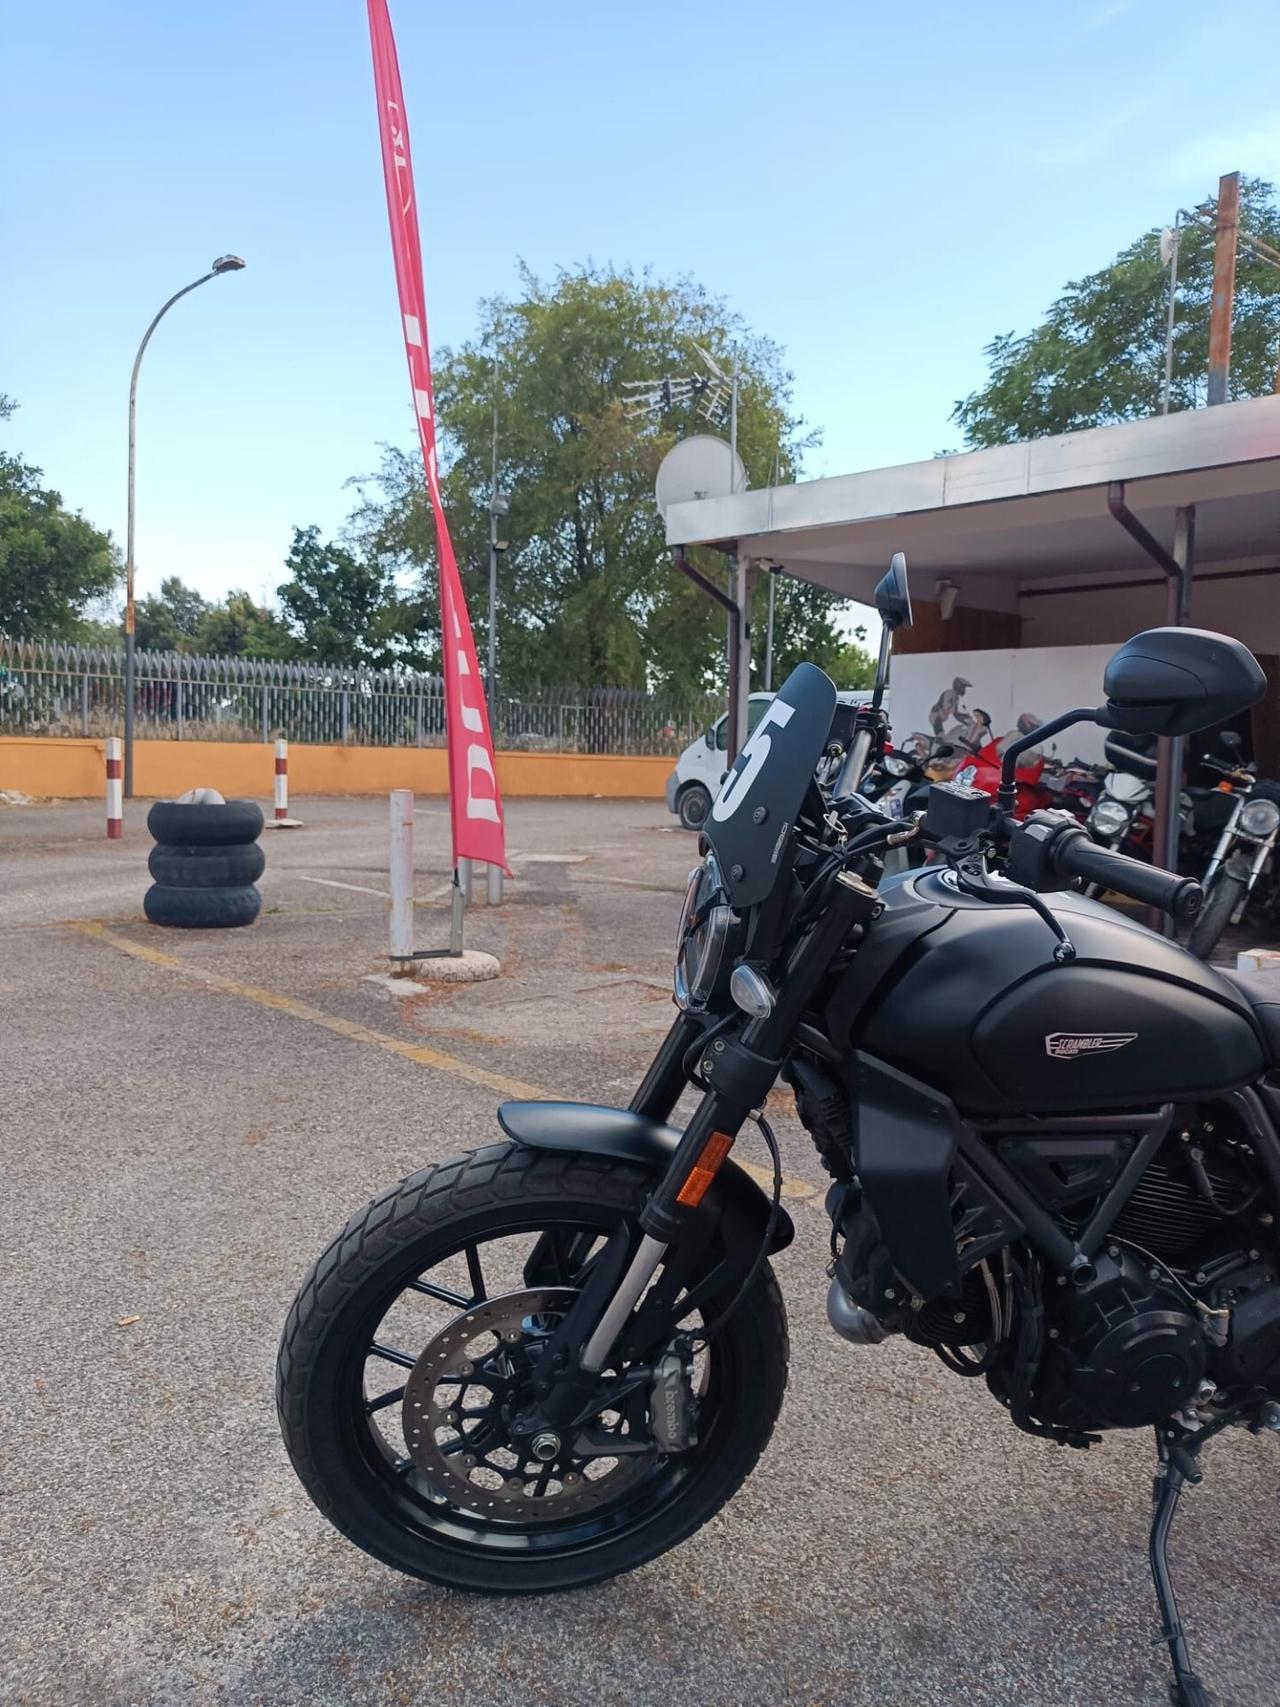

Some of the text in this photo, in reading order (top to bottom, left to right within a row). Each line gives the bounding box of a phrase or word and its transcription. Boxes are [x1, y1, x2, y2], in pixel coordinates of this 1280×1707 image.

[712, 697, 796, 823] 5
[1057, 1037, 1103, 1050] SCRAMBLER
[664, 1390, 680, 1440] brembo
